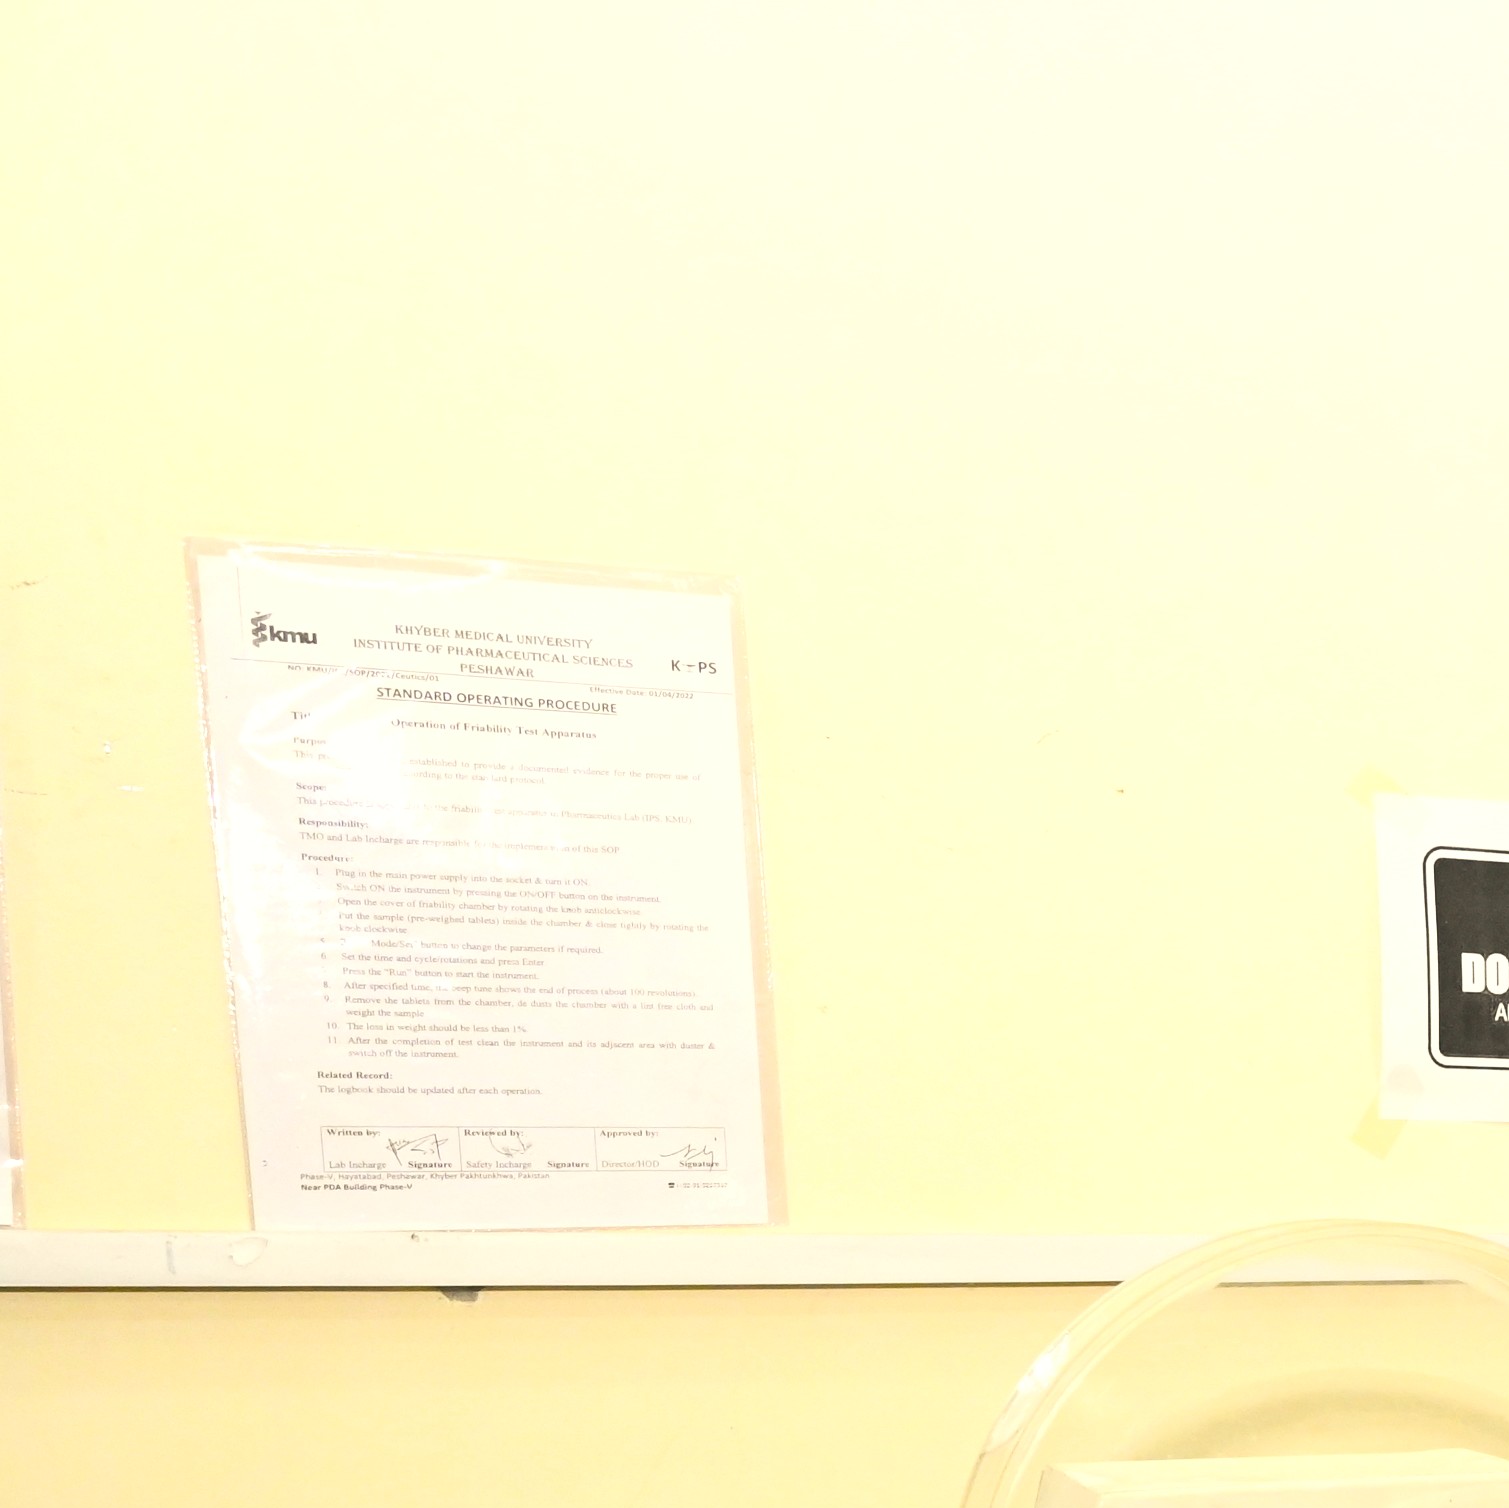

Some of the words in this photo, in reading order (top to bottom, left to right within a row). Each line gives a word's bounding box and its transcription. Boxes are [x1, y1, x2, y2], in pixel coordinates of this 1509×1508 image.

[269, 625, 318, 645] kmu
[394, 624, 450, 638] KHYBER
[454, 629, 513, 643] MEDICAL
[516, 634, 593, 649] UNIVERSITY
[353, 638, 423, 653] INSTITUTE
[425, 644, 442, 654] OF
[447, 645, 569, 664] PHARMACEUTICAL
[572, 655, 634, 668] SCIENCES
[460, 663, 534, 678] PESHAWAR
[376, 687, 453, 702] STANDARD
[456, 692, 534, 708] OPERATING
[538, 698, 617, 714] PROCEDURE
[449, 722, 460, 731] of
[463, 722, 512, 734] Friability
[518, 726, 538, 736] Test
[542, 728, 597, 739] Apparatus
[298, 817, 369, 830] Responsibility:
[1461, 953, 1509, 995] DO
[317, 1070, 353, 1079] Related
[355, 1071, 393, 1080] Record:
[326, 1128, 364, 1137] Written
[365, 1129, 381, 1138] by:
